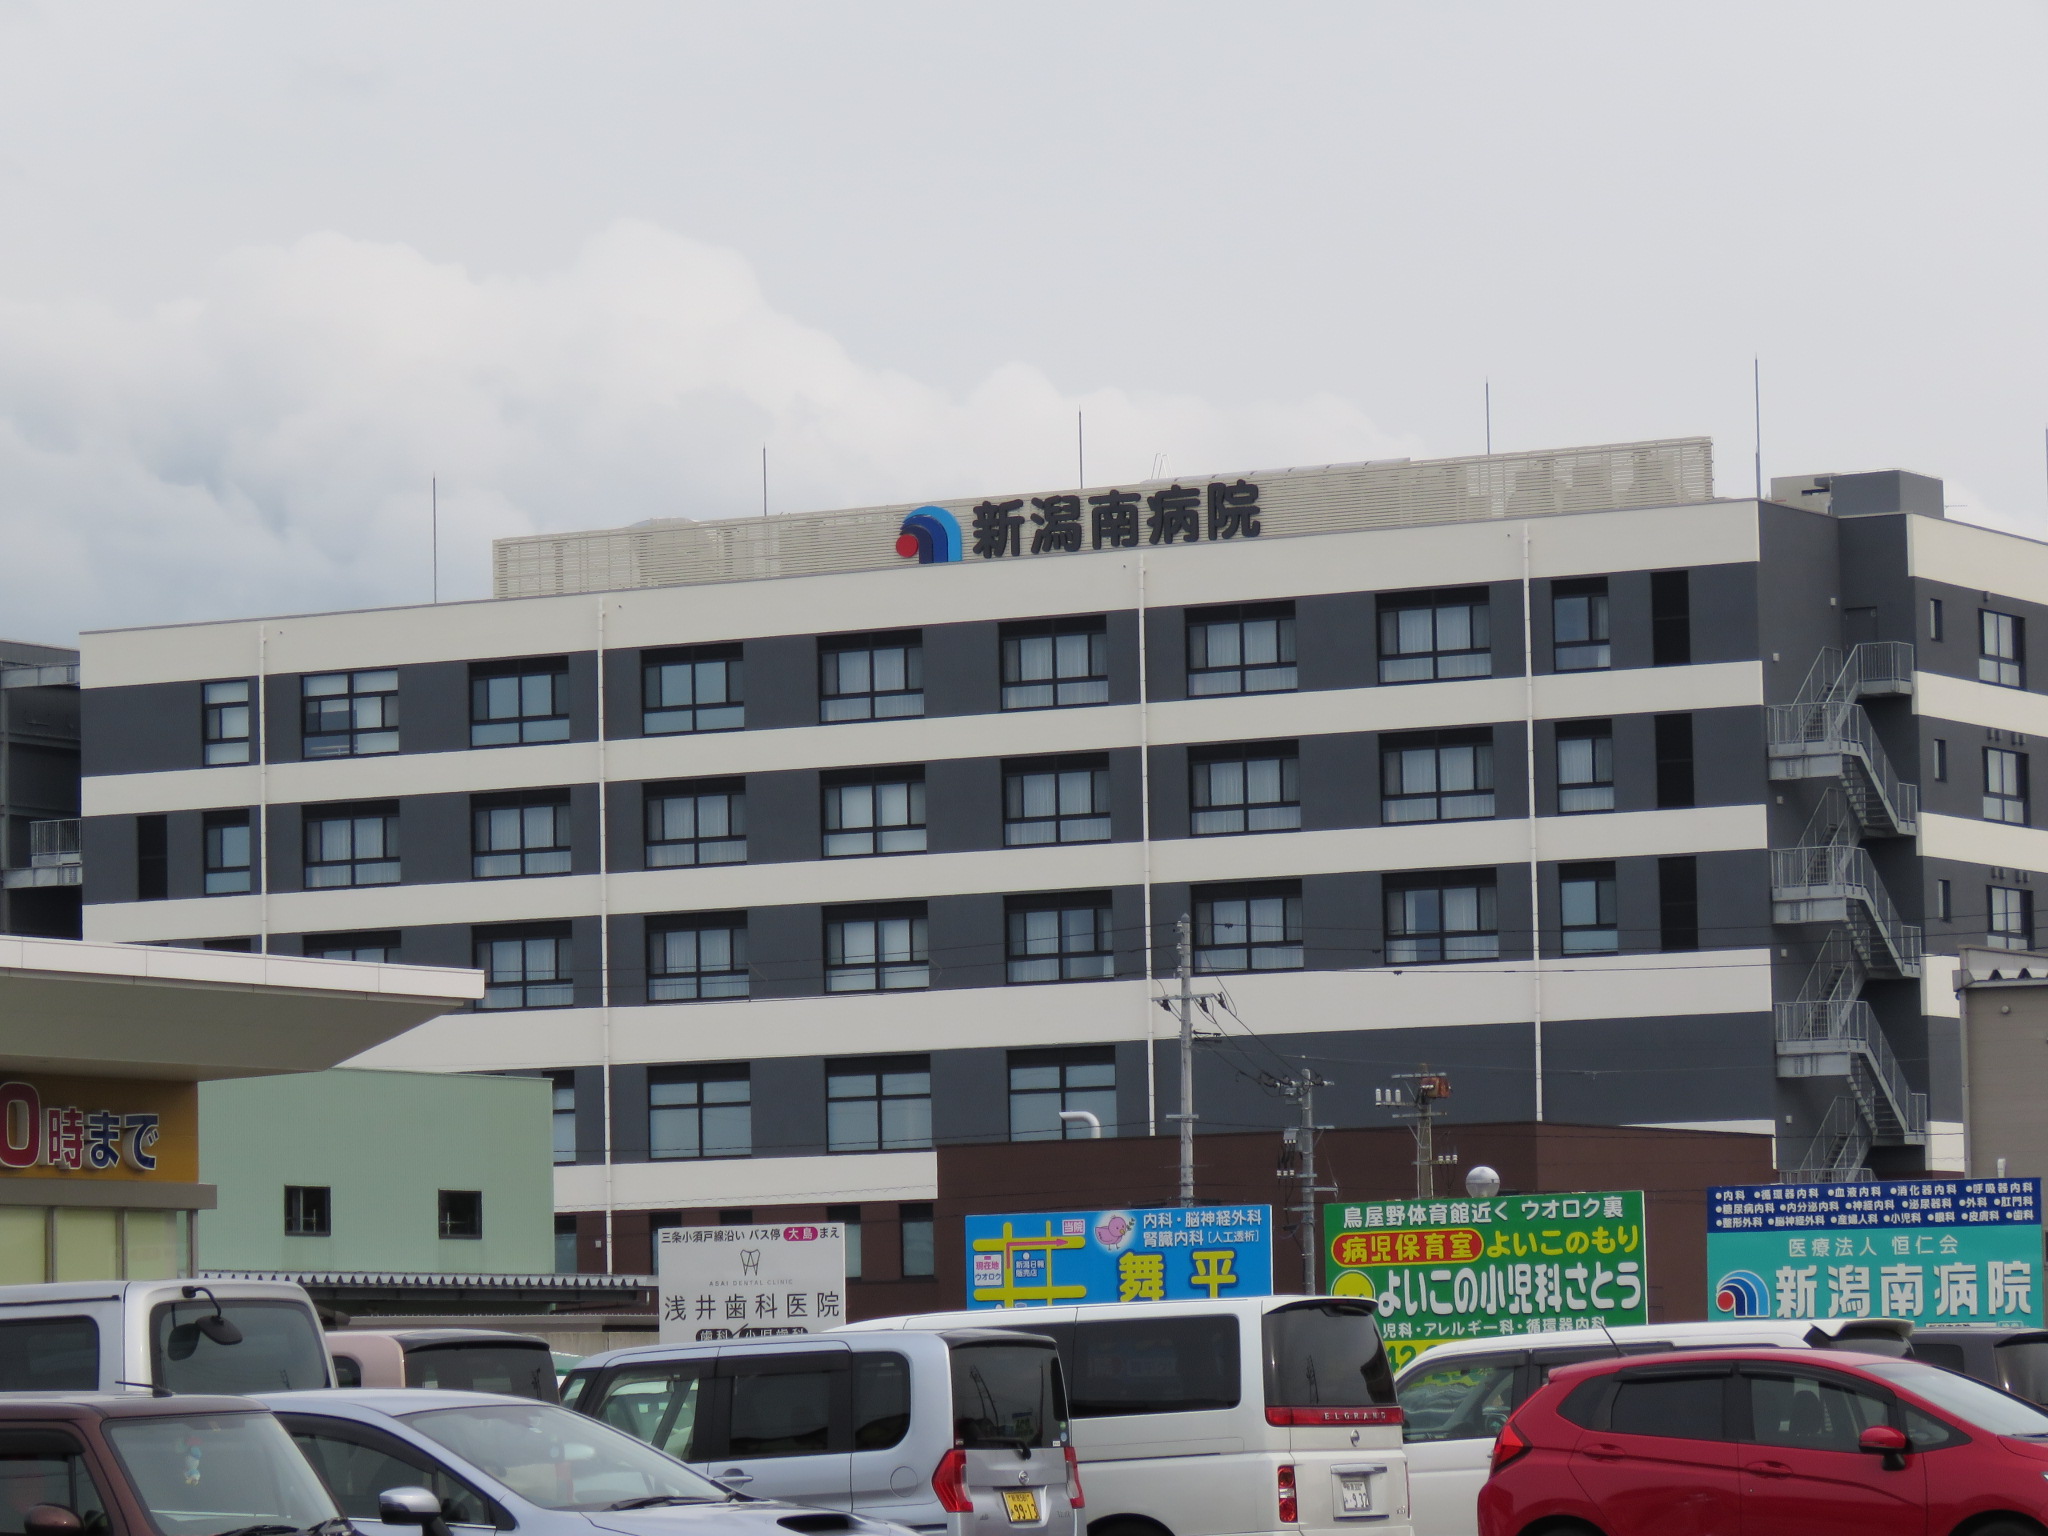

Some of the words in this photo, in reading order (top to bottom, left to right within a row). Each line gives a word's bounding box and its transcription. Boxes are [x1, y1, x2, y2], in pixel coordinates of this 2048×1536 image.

[972, 479, 1261, 559] 新潟南病院
[1343, 1201, 1508, 1229] 鳥屋野体育館近く
[1520, 1196, 1624, 1219] ウオロク裏
[661, 1230, 745, 1243] 三条小須戸線沿い
[749, 1228, 781, 1241] バス停
[1342, 1232, 1473, 1263] 病児保育室
[1486, 1225, 1639, 1258] よいこのもり
[1788, 1237, 1878, 1258] 医療法人
[1891, 1234, 1958, 1255] 恒仁会
[975, 1261, 1000, 1271] 現在地
[1377, 1260, 1642, 1318] よいこの小児科さとう
[1775, 1260, 2032, 1319] 新潟南病院
[664, 1290, 840, 1322] 浅井歯科医院
[1324, 1412, 1386, 1420] ELGRAND
